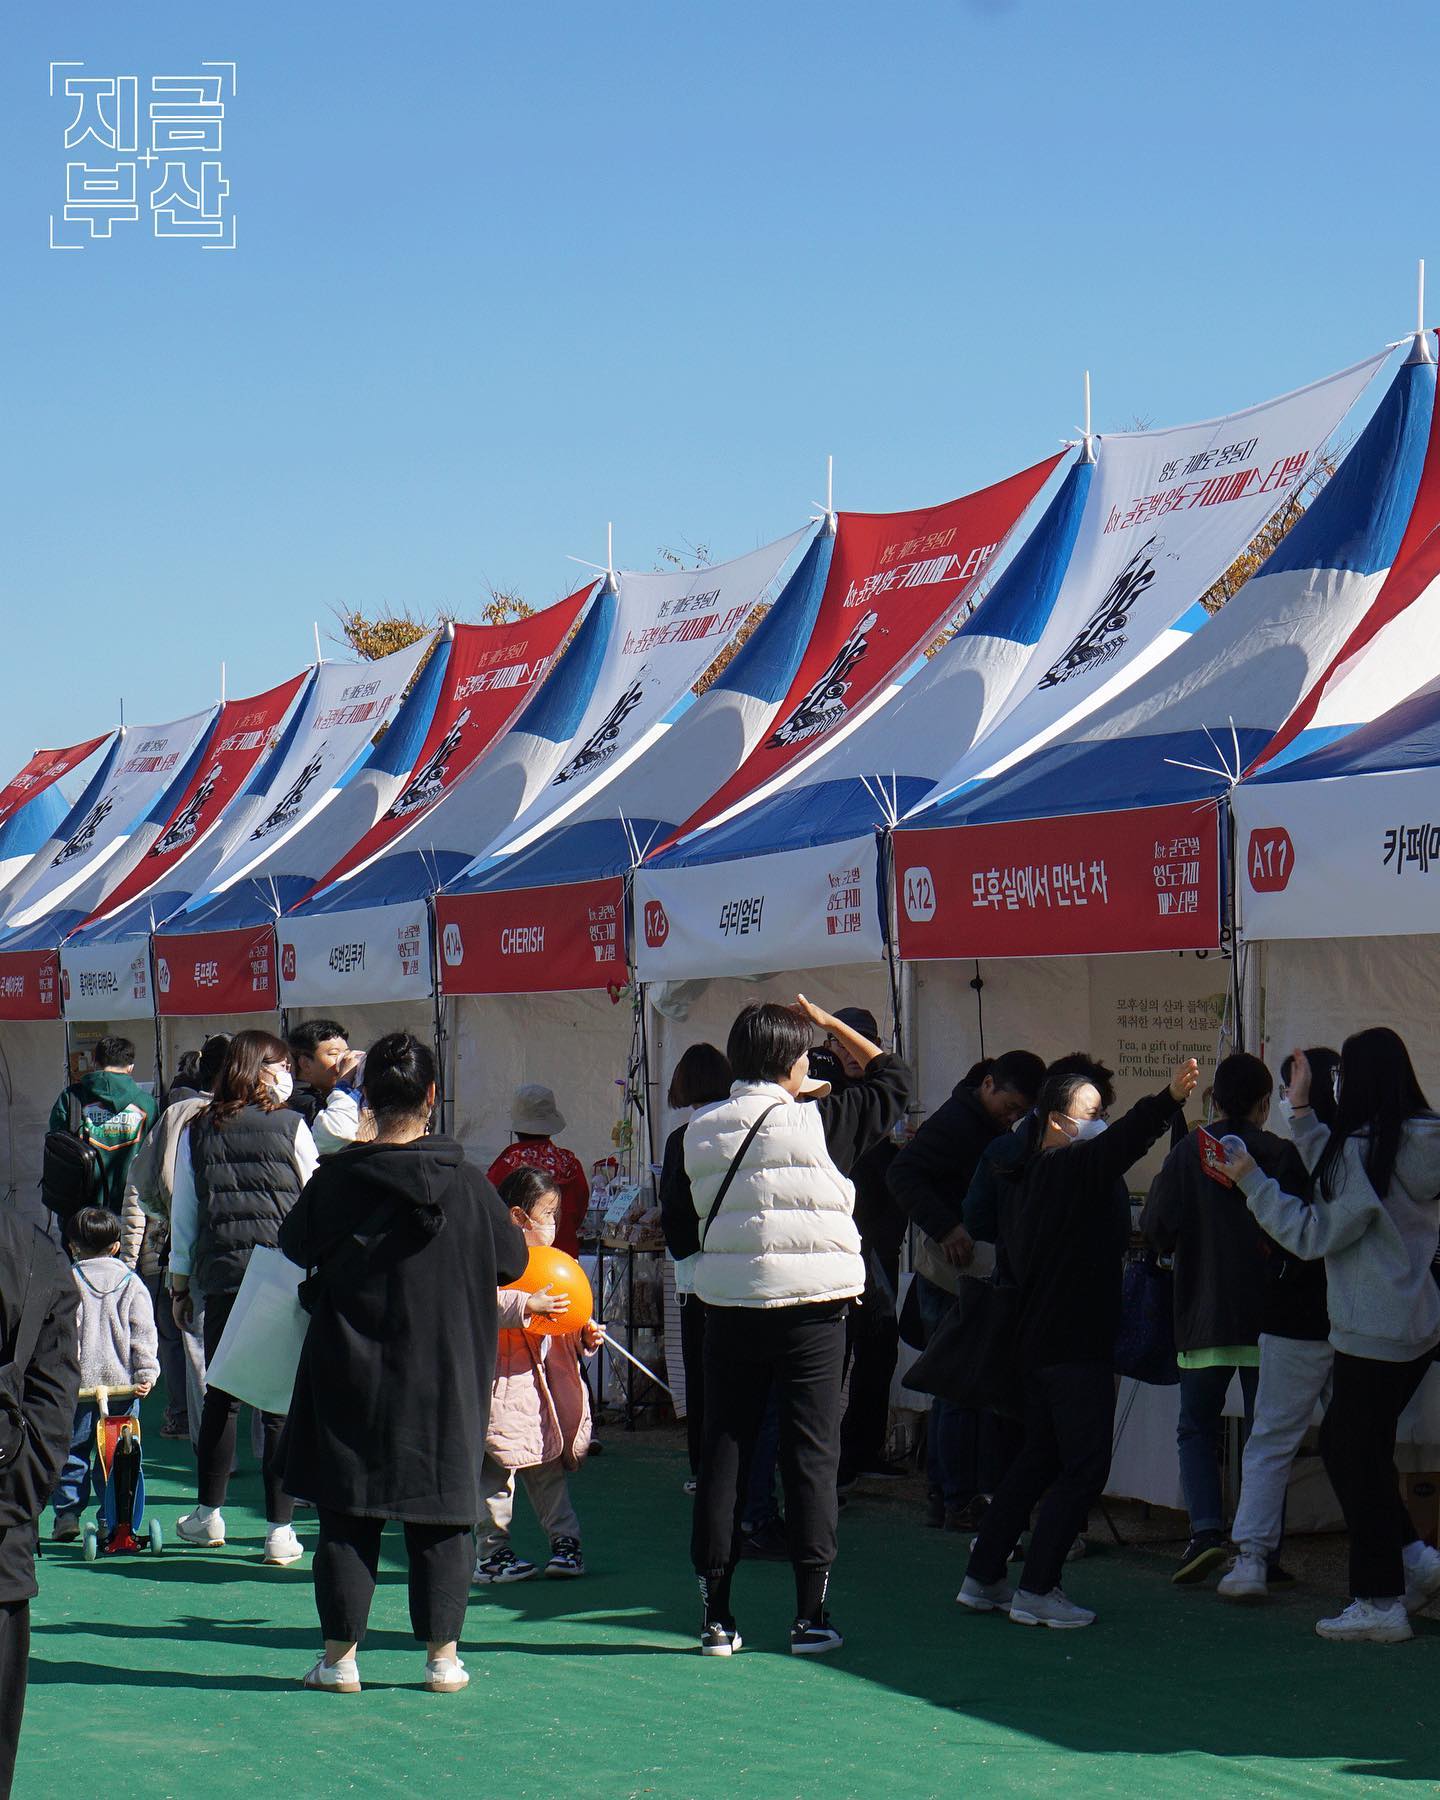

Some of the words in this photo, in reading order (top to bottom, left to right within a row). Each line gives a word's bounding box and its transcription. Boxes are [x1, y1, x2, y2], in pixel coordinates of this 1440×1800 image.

[1103, 504, 1121, 534] 1st
[1154, 841, 1166, 859] 1st
[1169, 837, 1200, 857] 글로벌
[1252, 840, 1288, 879] A11
[972, 864, 1051, 911] 모후실에서
[1052, 862, 1088, 906] 만난
[1089, 859, 1108, 904] 차
[1153, 862, 1199, 887] 영도커피
[908, 877, 933, 910] A12
[1157, 890, 1198, 915] 페스티벌
[648, 908, 666, 937] A13
[719, 895, 764, 937] 더리얼티
[501, 926, 545, 954] CHERISH
[1117, 998, 1159, 1013] 모후실의
[1162, 999, 1184, 1013] 산과
[1117, 1015, 1149, 1029] 채취한
[1152, 1016, 1184, 1030] 자연의
[1118, 1040, 1139, 1052] Tea,
[1142, 1043, 1147, 1051] a
[1150, 1040, 1167, 1053] gift
[1170, 1041, 1181, 1051] of
[1182, 1042, 1211, 1052] nature
[1120, 1052, 1141, 1063] from
[1145, 1054, 1159, 1064] the
[1162, 1053, 1185, 1065] field
[1118, 1066, 1130, 1077] of
[1133, 1066, 1172, 1078] Mohusil
